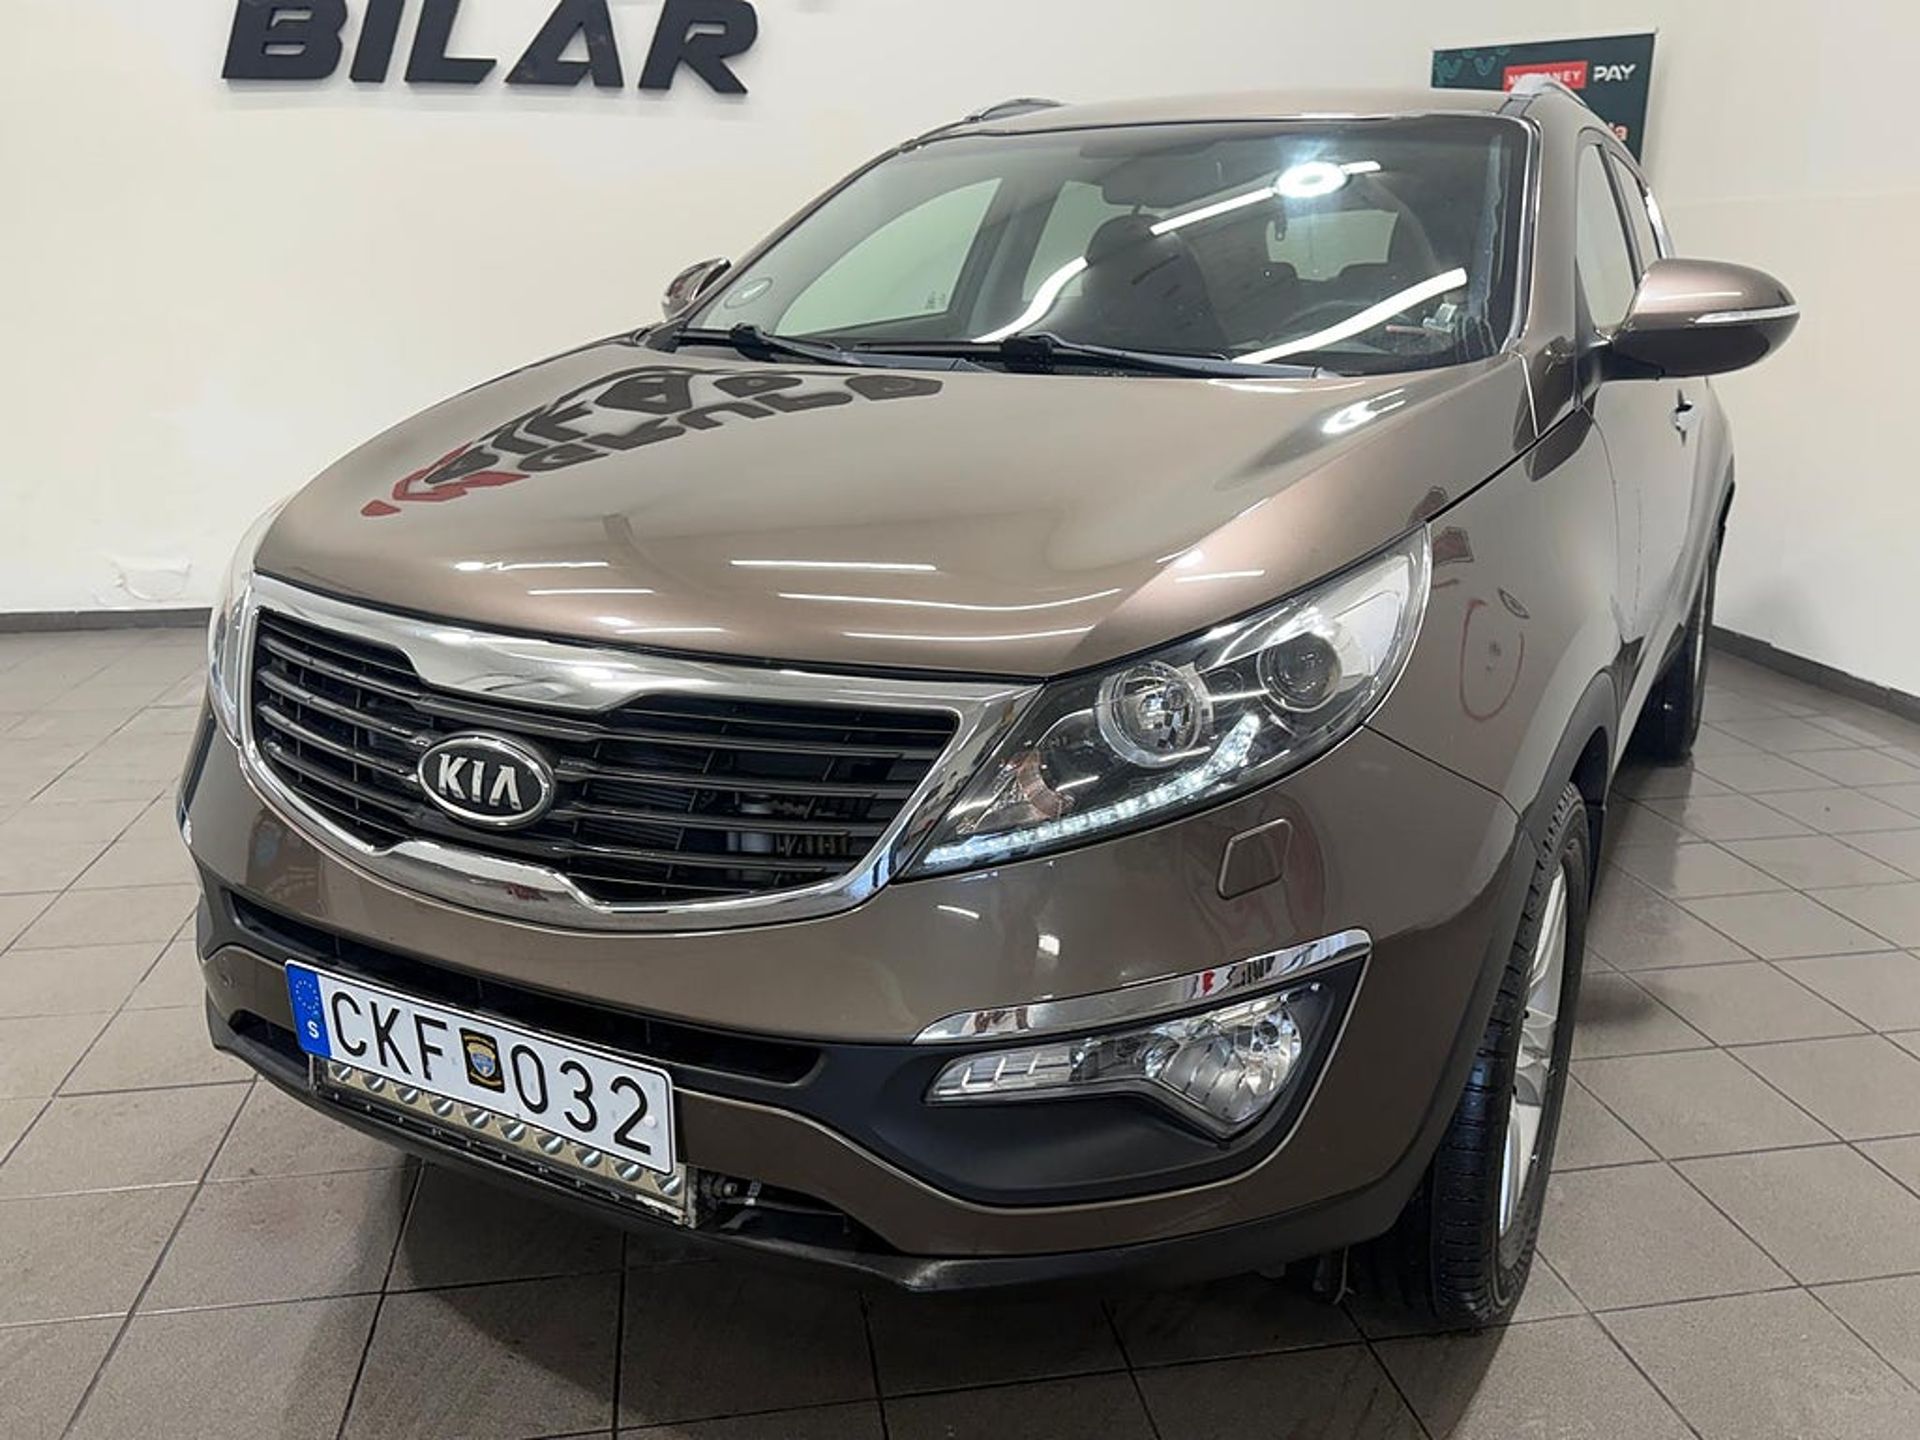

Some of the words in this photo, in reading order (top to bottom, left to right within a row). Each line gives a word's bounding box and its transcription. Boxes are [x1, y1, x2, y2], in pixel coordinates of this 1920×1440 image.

[222, 0, 759, 94] BILAR
[1593, 63, 1636, 83] PAY
[438, 753, 523, 811] KIA
[306, 1020, 320, 1040] S
[330, 990, 449, 1081] CKF
[510, 1043, 652, 1156] 032
